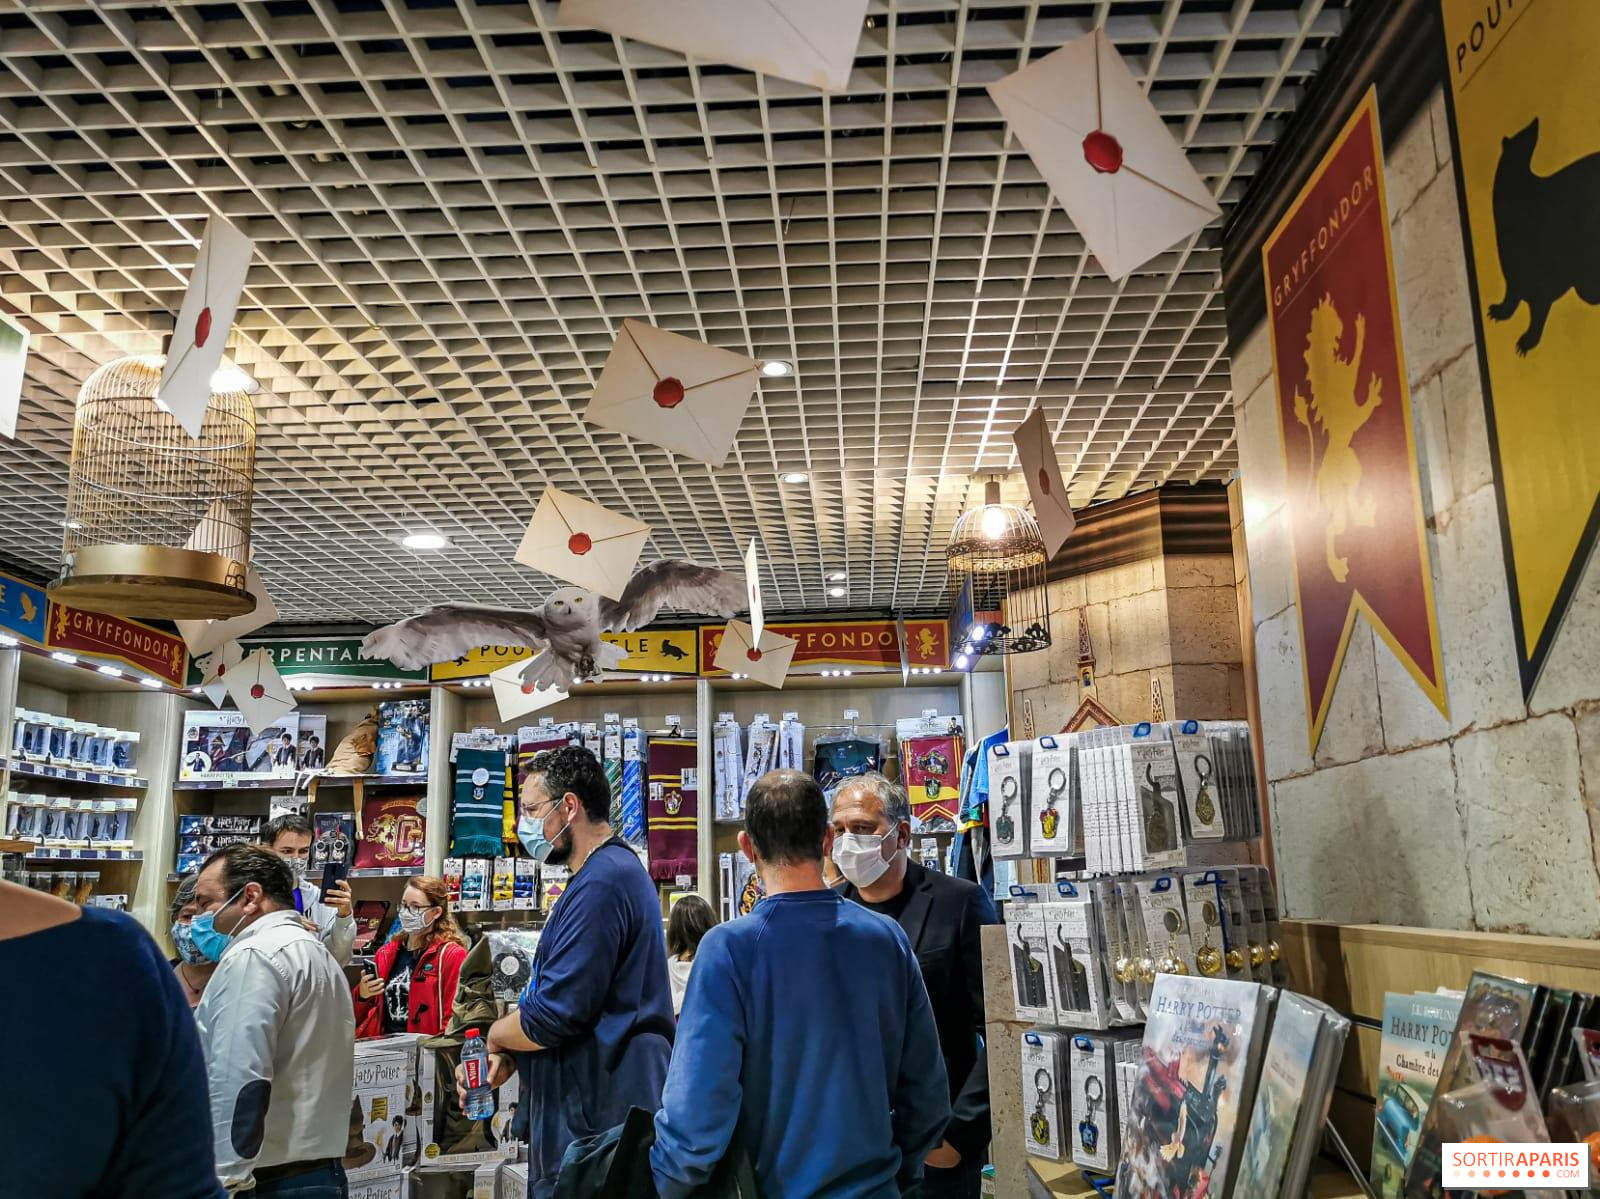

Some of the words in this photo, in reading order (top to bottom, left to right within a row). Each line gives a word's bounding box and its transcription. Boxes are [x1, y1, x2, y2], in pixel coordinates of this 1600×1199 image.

[1457, 0, 1513, 73] POU
[1274, 165, 1374, 307] GRYFFONDOR
[72, 612, 169, 659] GRYFFONDOR
[1156, 996, 1195, 1017] HARRY
[1195, 1001, 1242, 1021] POTTER
[1390, 1016, 1429, 1043] HARRY
[375, 1064, 400, 1086] Potter
[1396, 1054, 1426, 1075] Chambre
[1427, 1062, 1440, 1078] des
